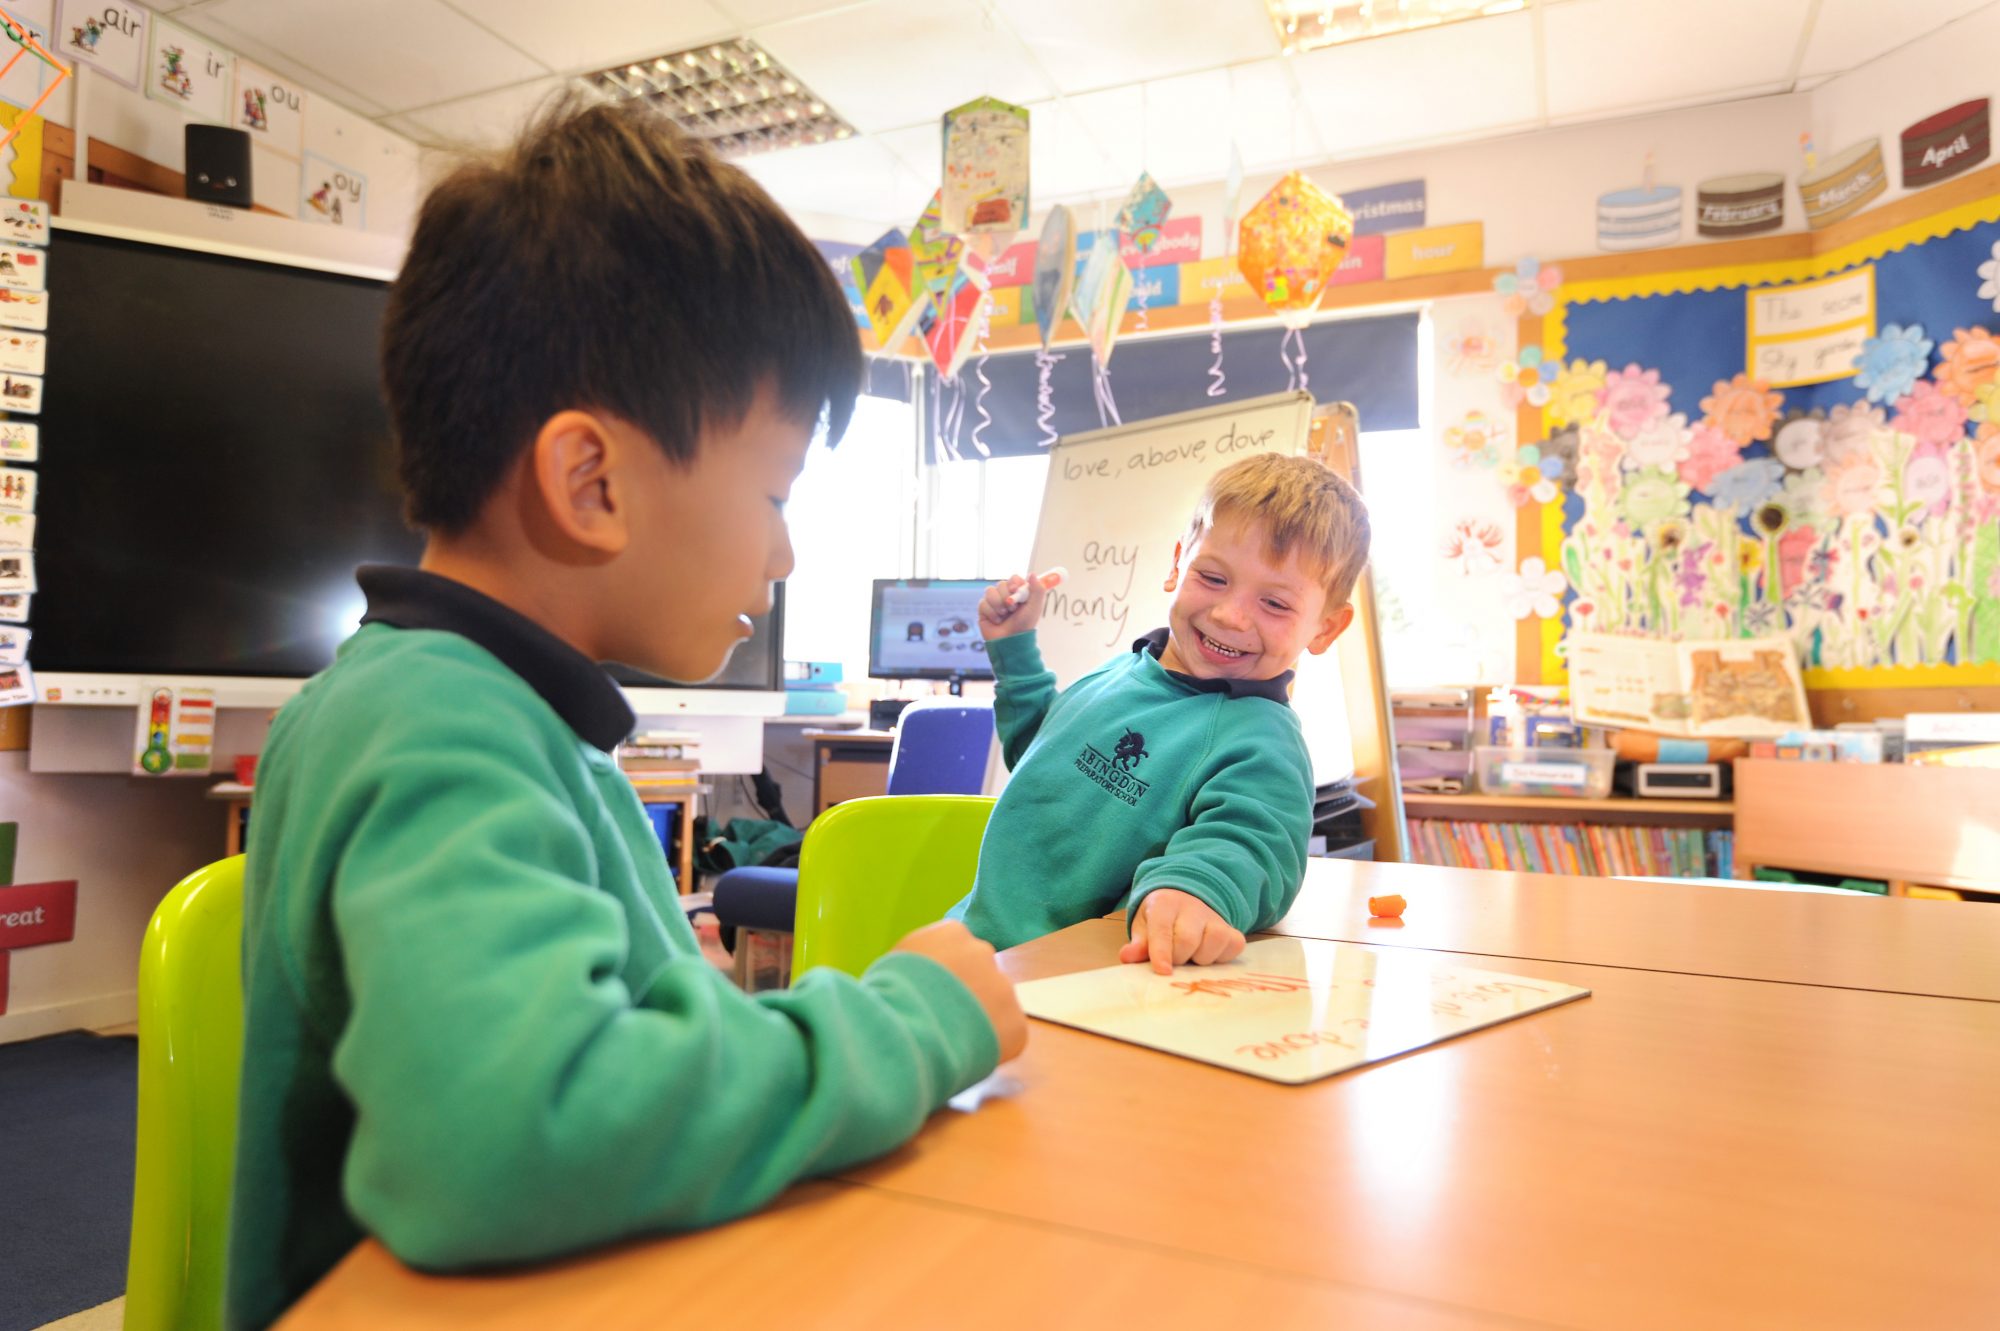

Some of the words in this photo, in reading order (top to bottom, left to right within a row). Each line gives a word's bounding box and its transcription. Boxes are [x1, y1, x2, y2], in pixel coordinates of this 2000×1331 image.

[103, 8, 141, 38] air
[206, 52, 225, 79] ir
[270, 85, 300, 113] ou
[1920, 134, 1970, 168] April
[333, 173, 362, 203] oy
[1818, 171, 1872, 208] March
[1215, 422, 1276, 451] dove
[1083, 540, 1139, 602] any
[1042, 588, 1129, 648] many
[1074, 758, 1116, 794] PREPARATORY
[1079, 749, 1147, 798] ABINGDON
